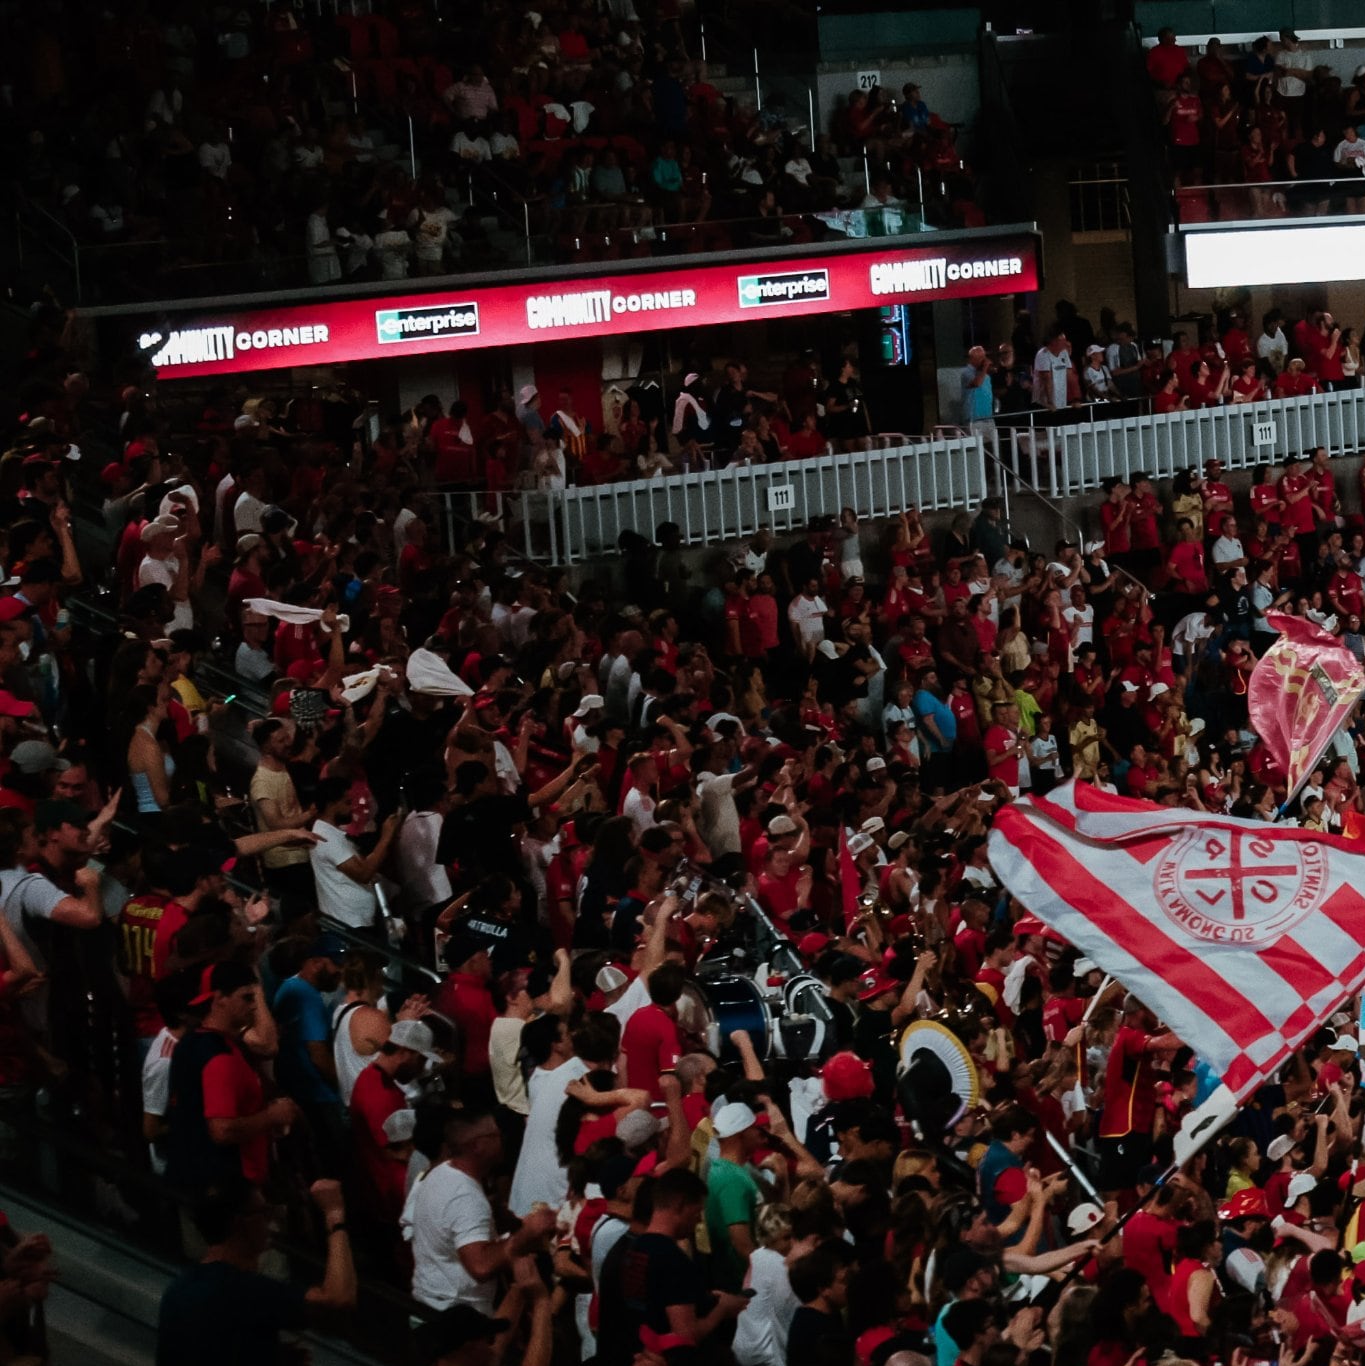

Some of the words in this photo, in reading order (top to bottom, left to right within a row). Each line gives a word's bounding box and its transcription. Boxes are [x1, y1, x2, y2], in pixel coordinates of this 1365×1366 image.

[860, 74, 878, 89] 212
[741, 273, 828, 302] enterprise
[871, 257, 947, 296] COMMUNITY
[947, 257, 1023, 282] CORNER
[381, 309, 478, 336] enterprise
[526, 289, 612, 330] COMMUNITY
[612, 289, 696, 315] CORNER
[235, 325, 329, 351] CORNER
[1258, 426, 1272, 441] 111
[774, 490, 789, 506] 111
